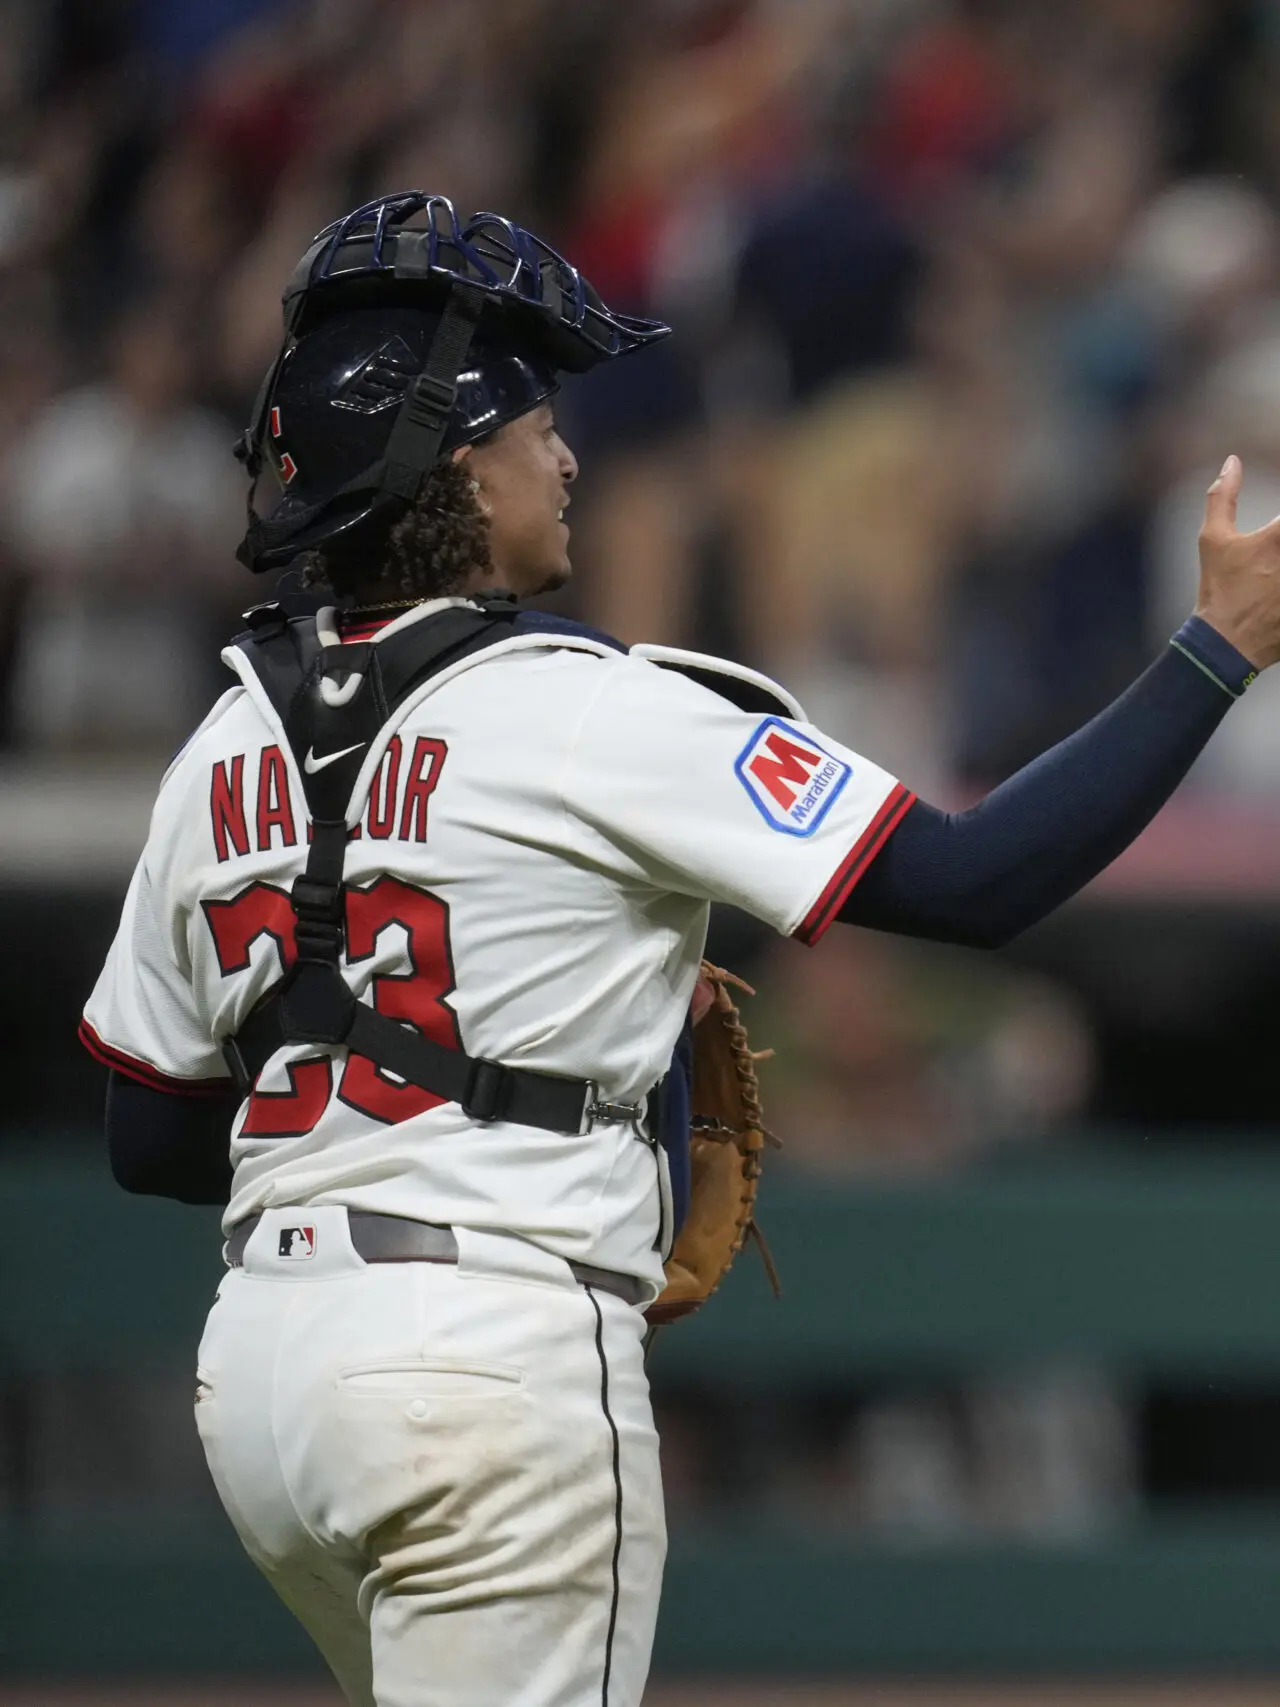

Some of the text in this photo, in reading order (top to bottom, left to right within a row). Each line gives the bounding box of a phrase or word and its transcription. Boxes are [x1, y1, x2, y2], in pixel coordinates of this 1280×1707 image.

[210, 734, 448, 864] NAOR
[748, 731, 822, 812] M
[790, 760, 840, 824] Marathon
[199, 872, 463, 1139] 23
